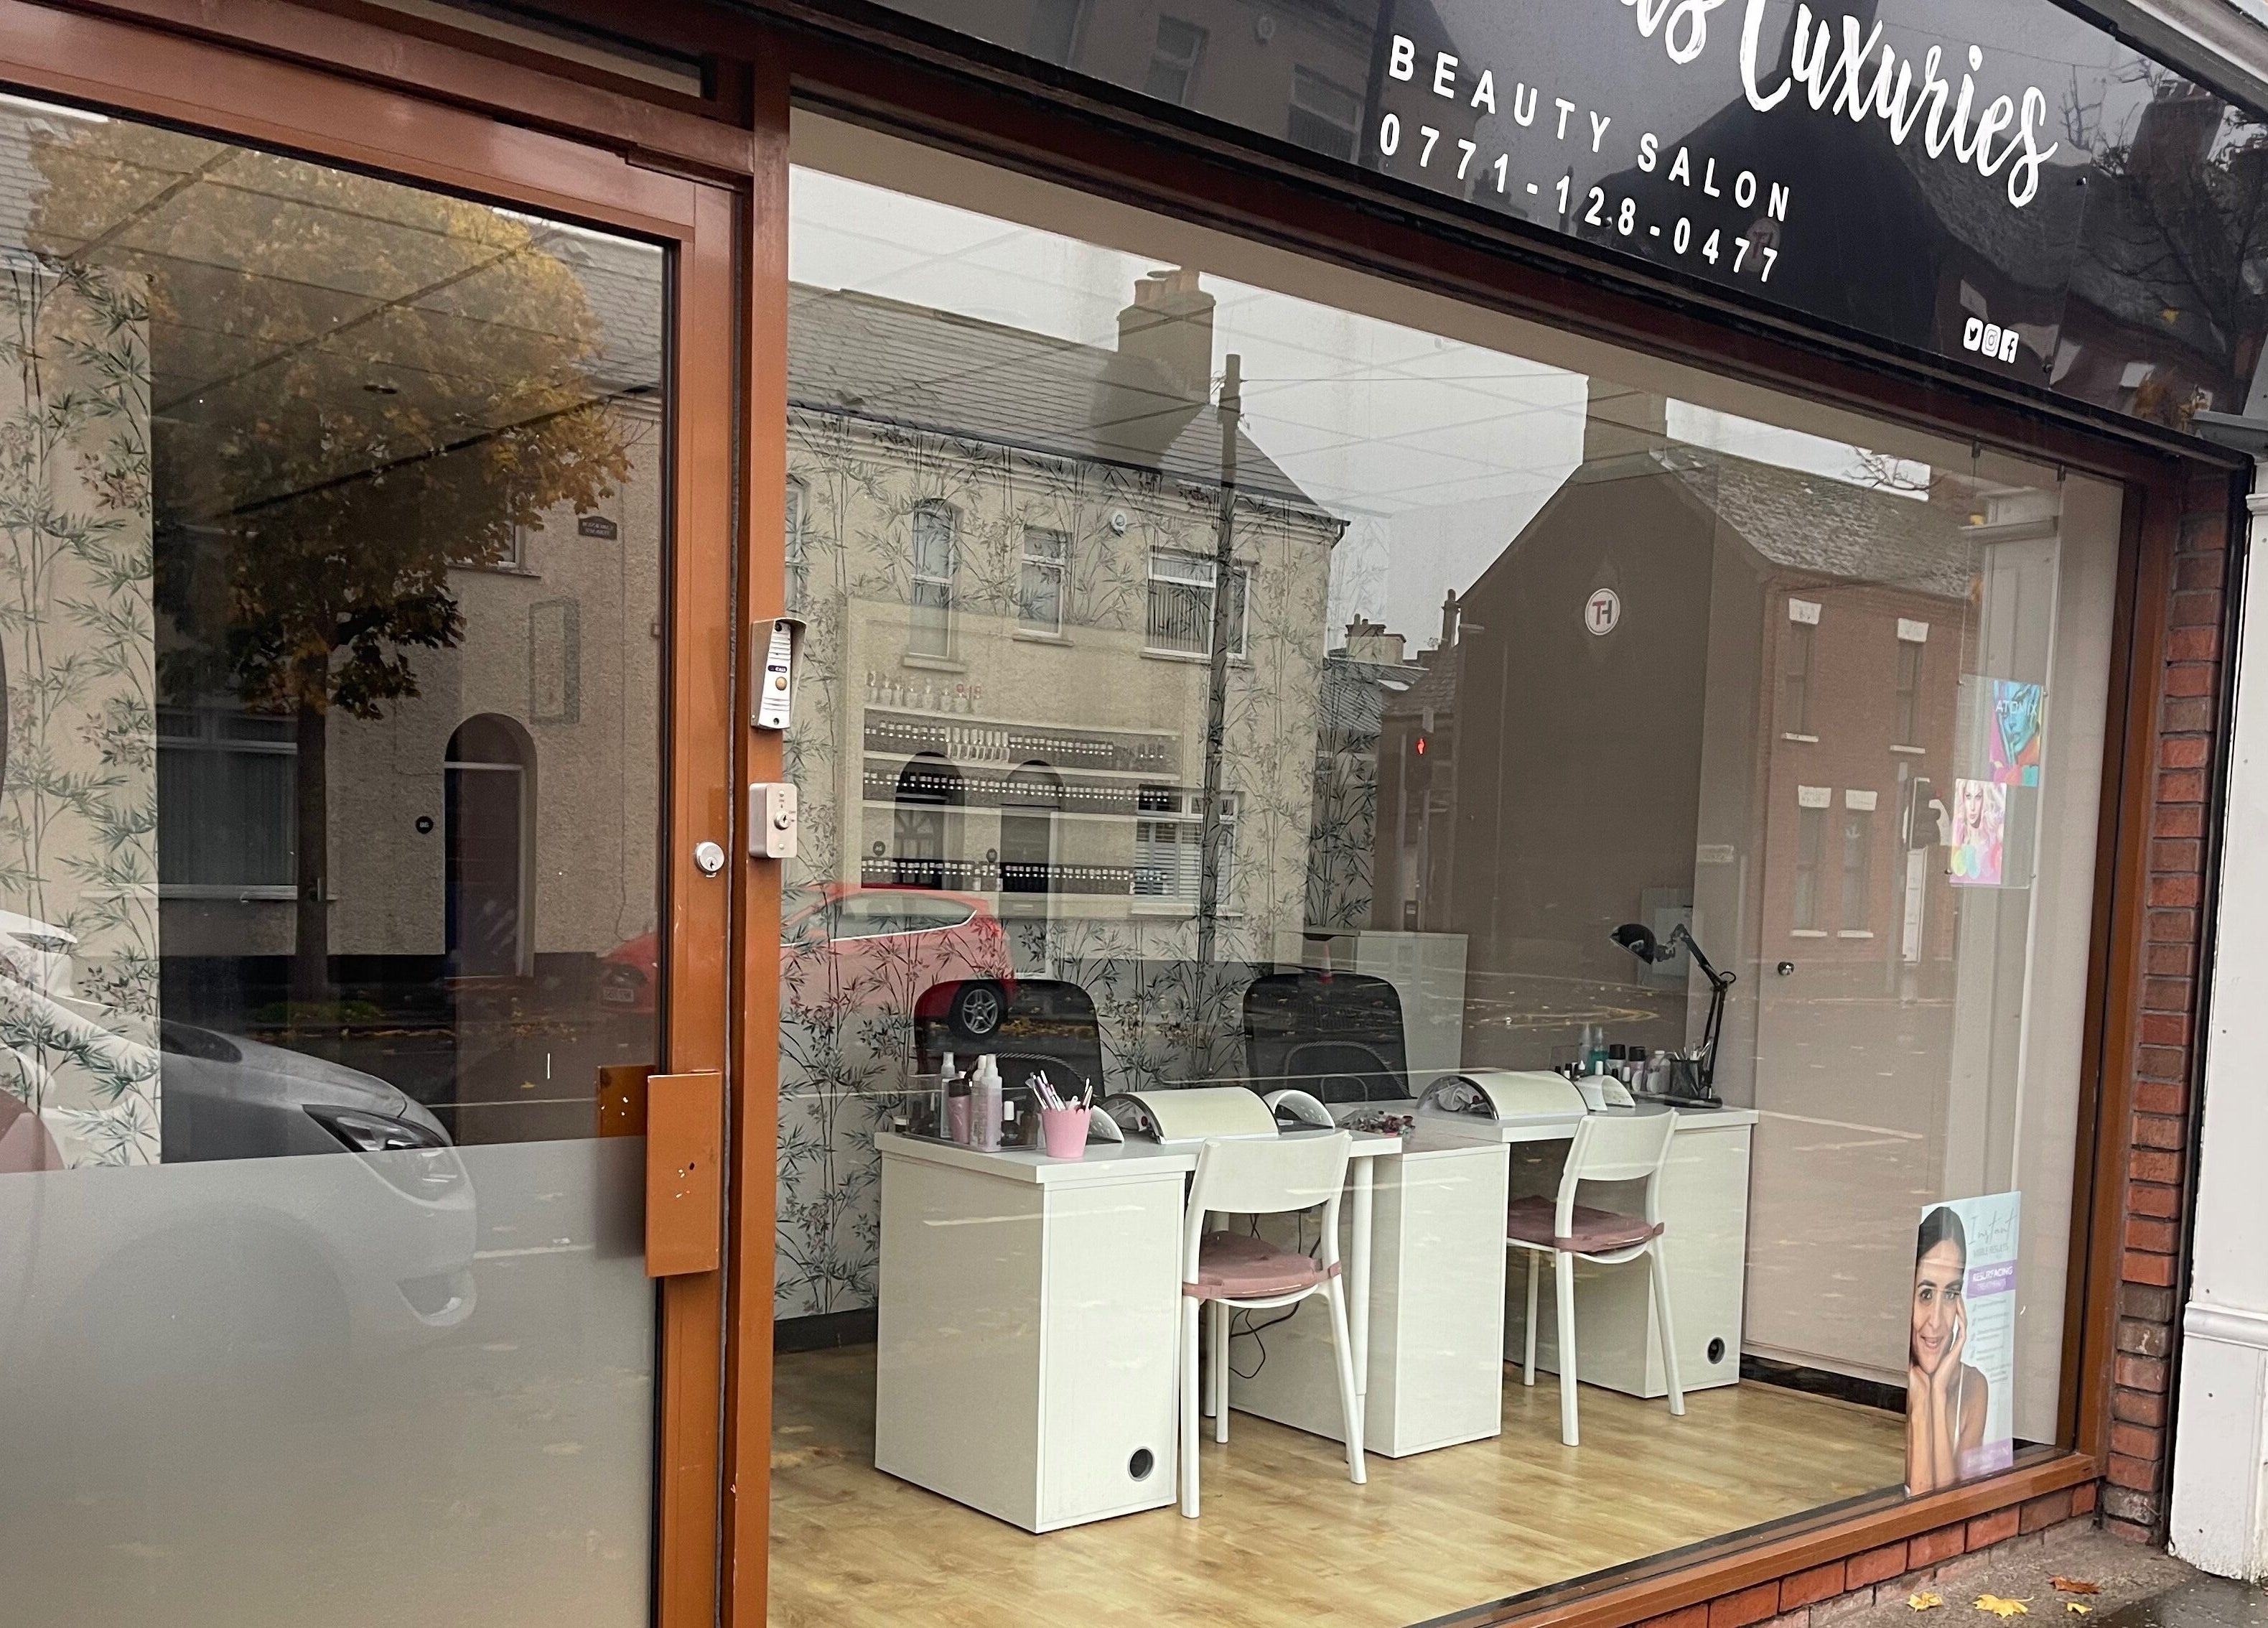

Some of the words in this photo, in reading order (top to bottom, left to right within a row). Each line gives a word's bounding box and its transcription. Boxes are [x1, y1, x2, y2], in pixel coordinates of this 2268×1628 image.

[1389, 34, 1611, 153] BEAUTY
[1637, 132, 1789, 222] SALON
[1740, 0, 2058, 208] Luxuries
[1380, 113, 1778, 282] 0771-128-0477
[1972, 1265, 2013, 1282] RESURFACING
